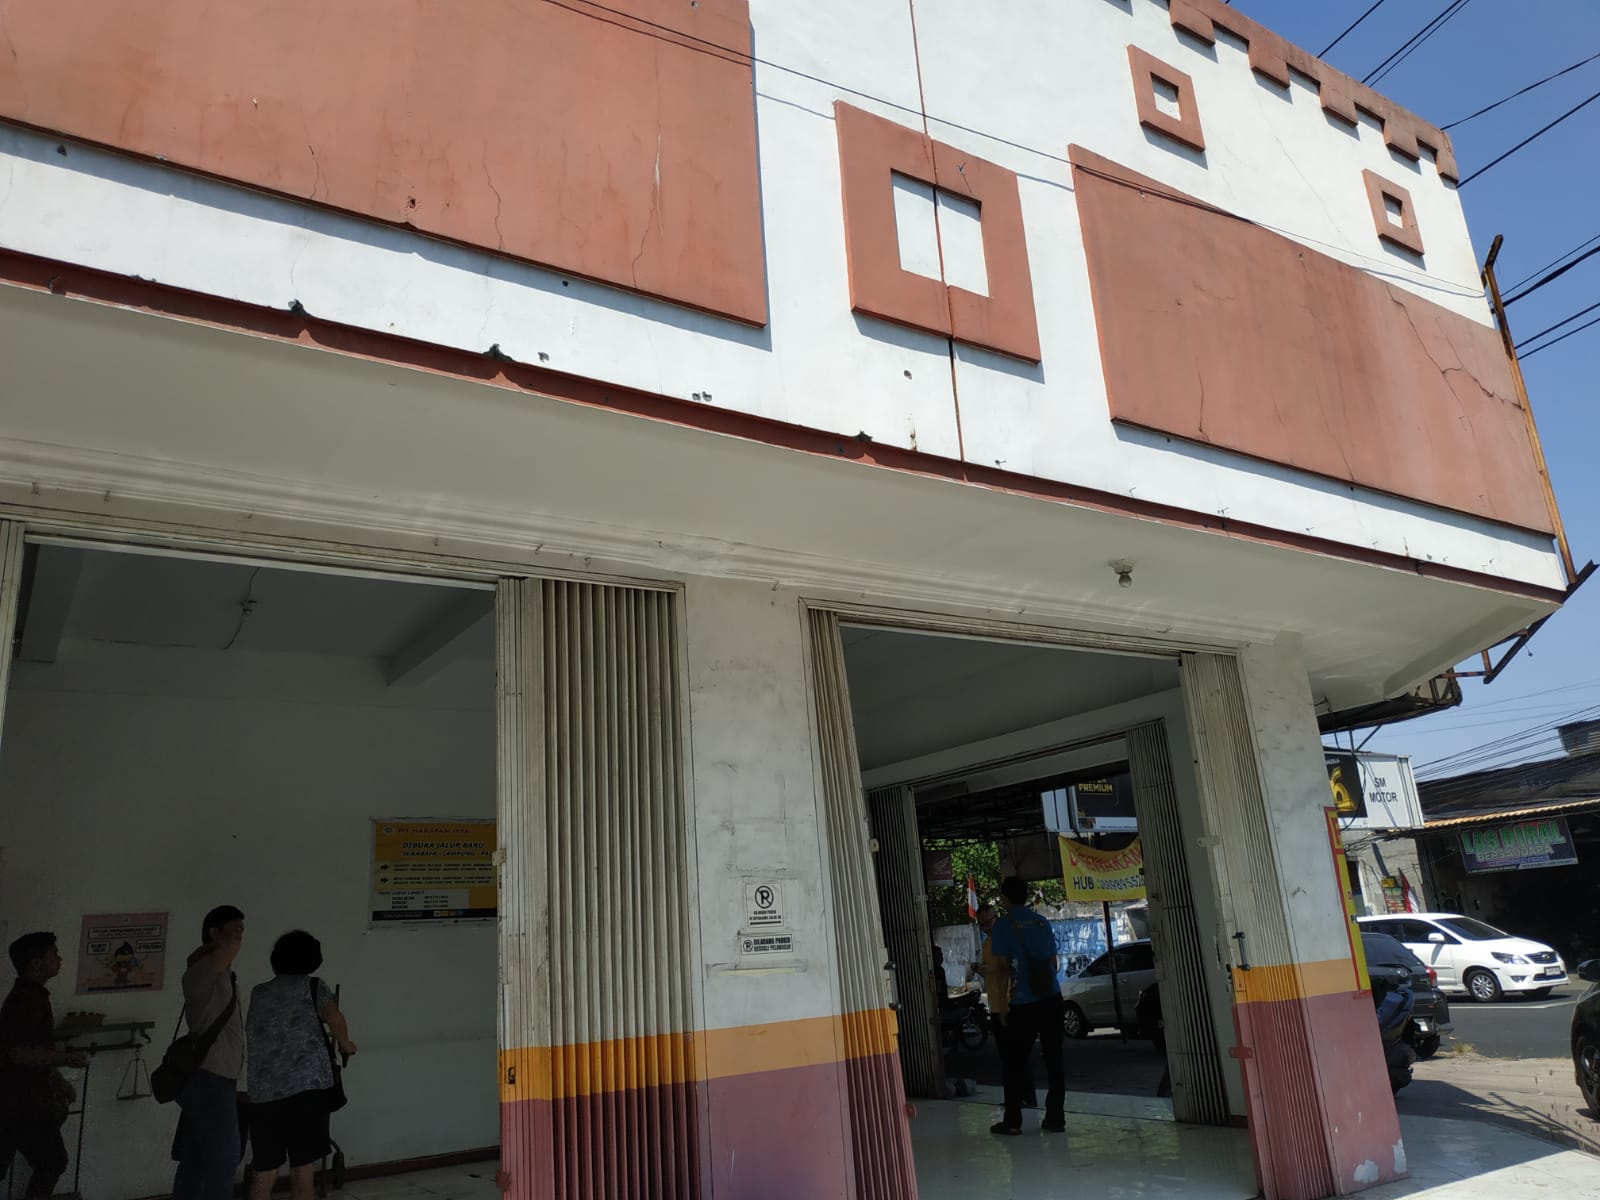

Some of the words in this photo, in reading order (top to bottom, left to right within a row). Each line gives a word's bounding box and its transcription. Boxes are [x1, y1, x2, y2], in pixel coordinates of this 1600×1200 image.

[1079, 783, 1113, 793] PREMIUM
[1374, 777, 1387, 789] SM
[1369, 791, 1398, 803] MOTOR
[436, 841, 460, 849] JALUR
[462, 841, 485, 849] BARU
[1462, 830, 1499, 855] LAS
[1073, 875, 1094, 890] HUB
